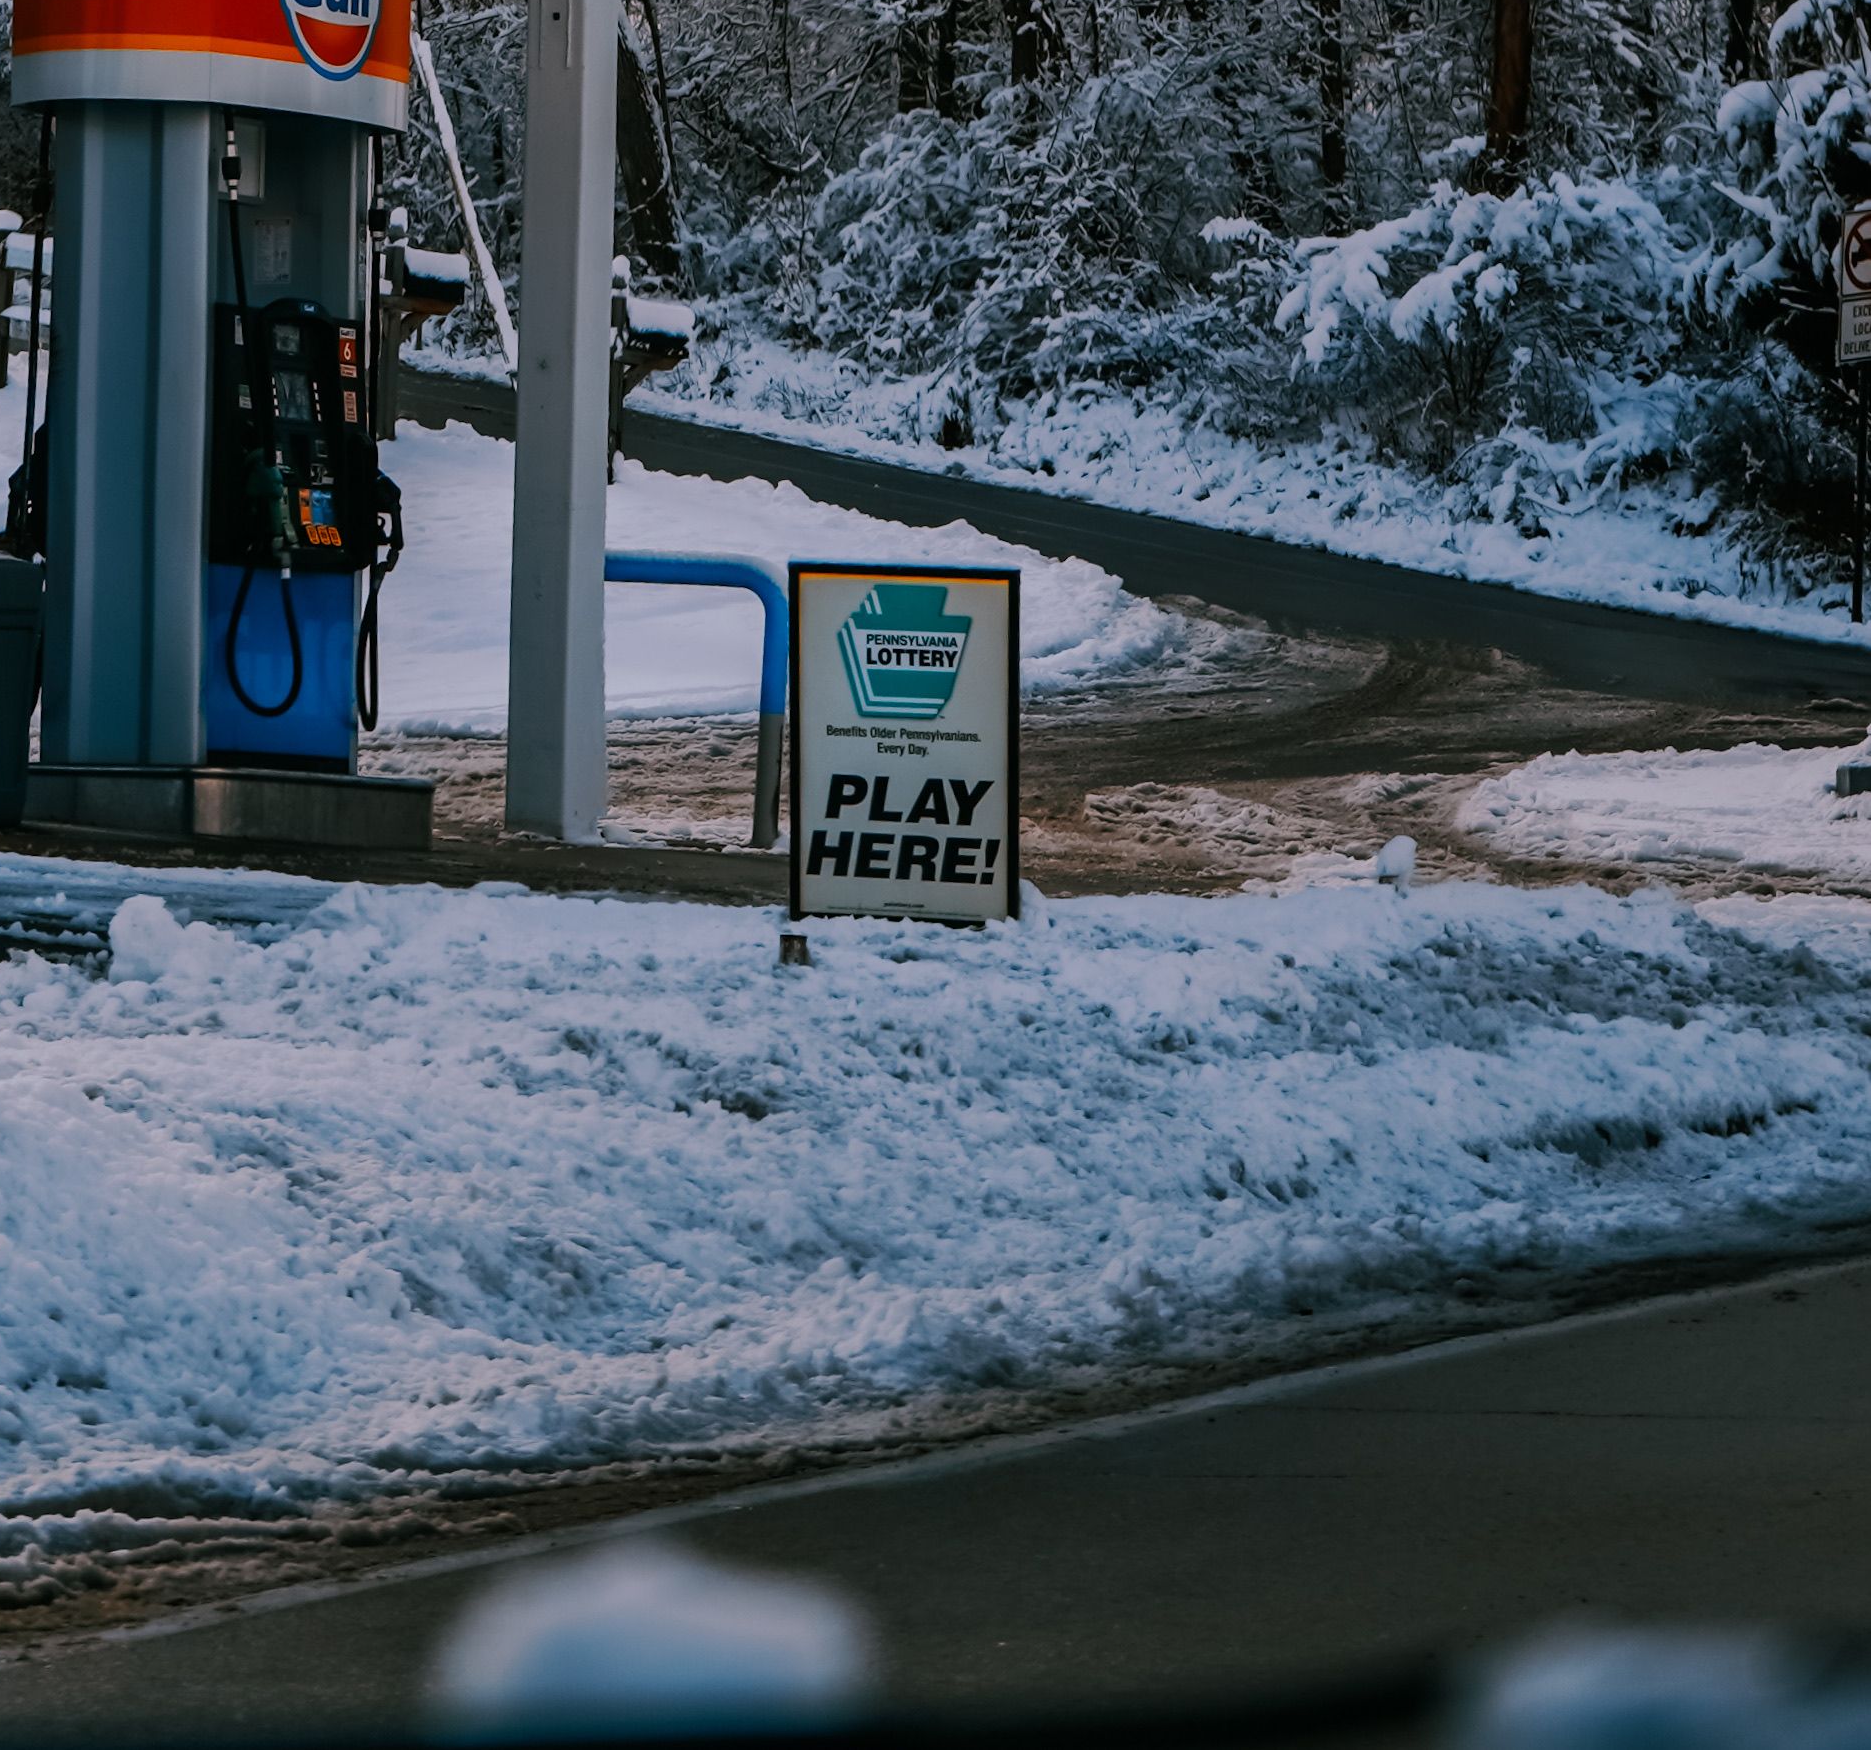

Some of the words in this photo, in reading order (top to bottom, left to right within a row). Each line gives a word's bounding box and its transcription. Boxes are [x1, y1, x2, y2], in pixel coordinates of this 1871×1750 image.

[1854, 322, 1871, 335] LOC
[344, 342, 352, 360] 6
[866, 633, 958, 648] PENNSYLVANIA
[866, 648, 958, 668] LOTTERY
[826, 724, 868, 737] Benefits
[870, 726, 896, 739] Older
[900, 728, 982, 743] Pennsylvanians.
[877, 742, 905, 757] Every
[908, 743, 930, 758] Day.
[825, 773, 995, 826] PLAY
[806, 830, 1001, 886] HERE!
